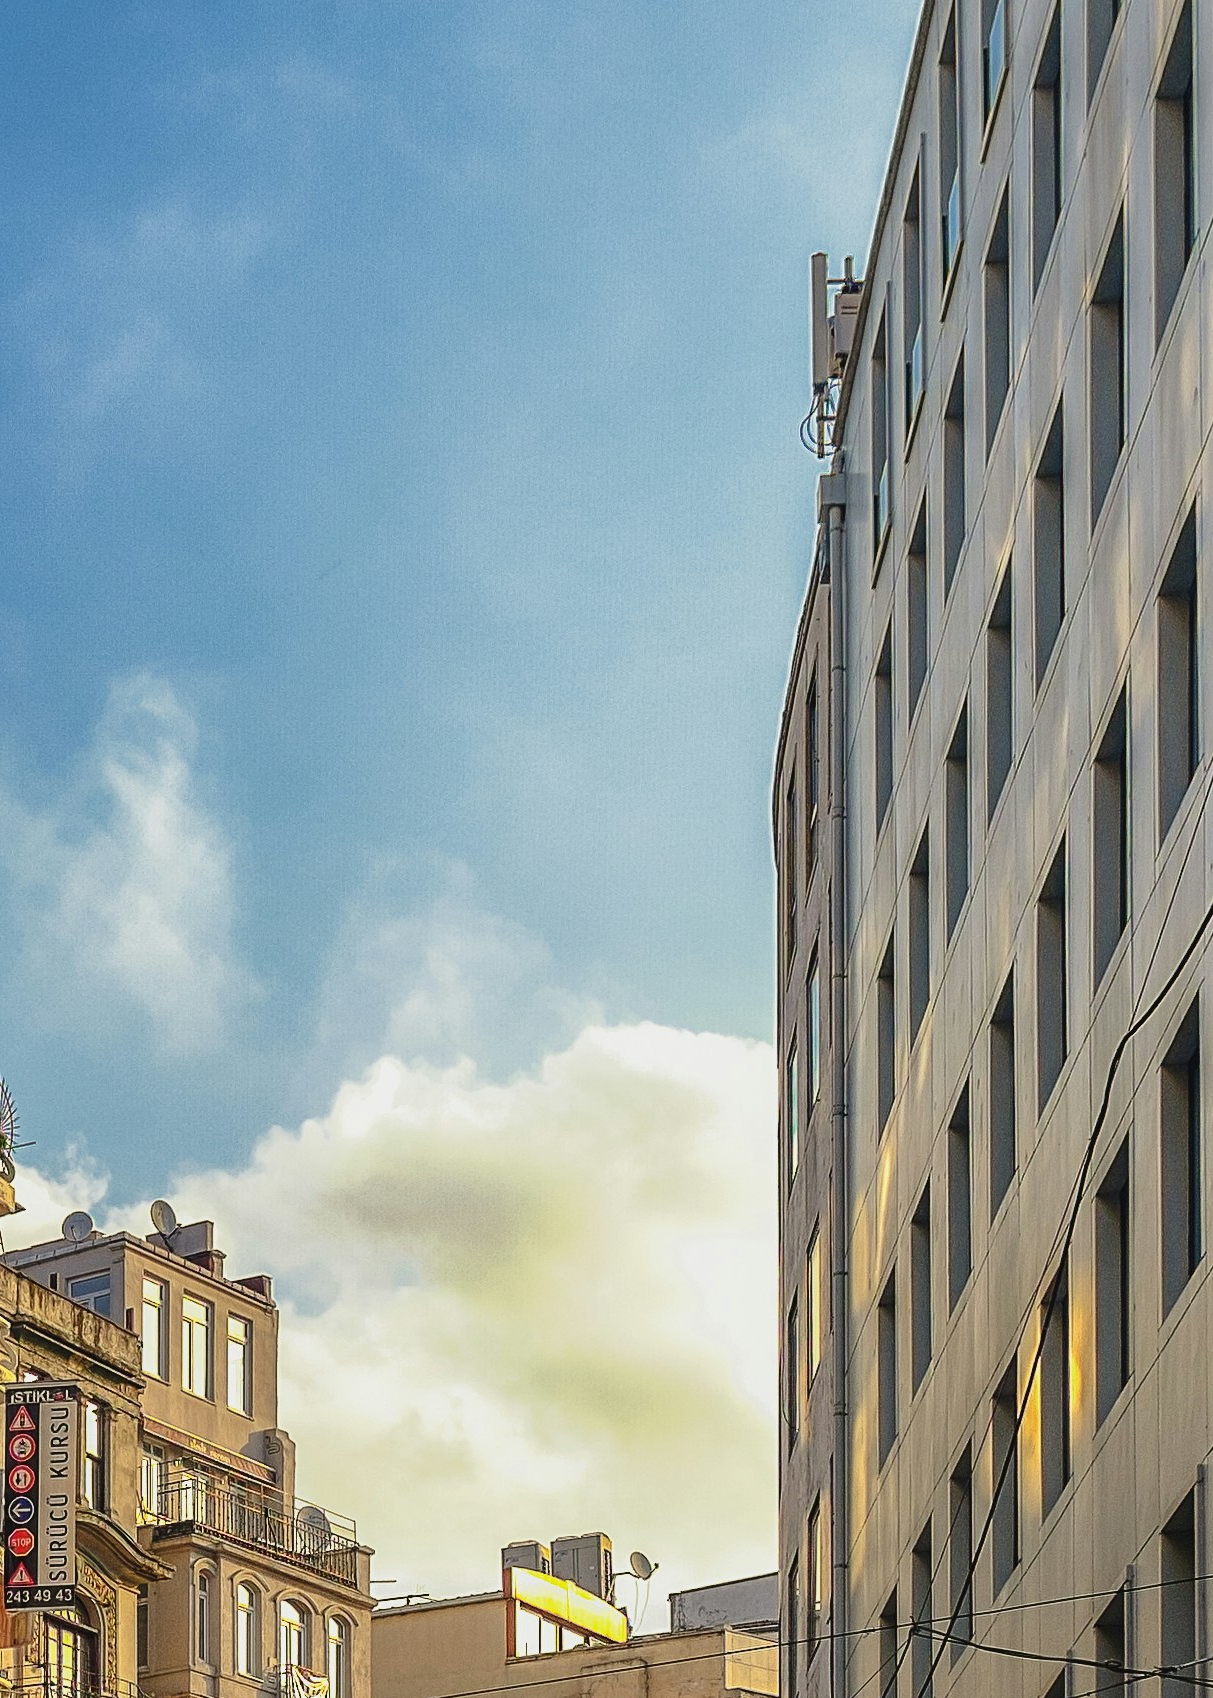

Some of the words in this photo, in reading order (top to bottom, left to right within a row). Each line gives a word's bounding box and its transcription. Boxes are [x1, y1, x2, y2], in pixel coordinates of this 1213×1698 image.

[50, 1407, 69, 1478] KURSU
[11, 1538, 31, 1547] STOP
[45, 1494, 68, 1581] SÜRÜCÜ
[6, 1590, 29, 1604] 243
[34, 1590, 51, 1603] 49
[56, 1588, 72, 1601] 43
